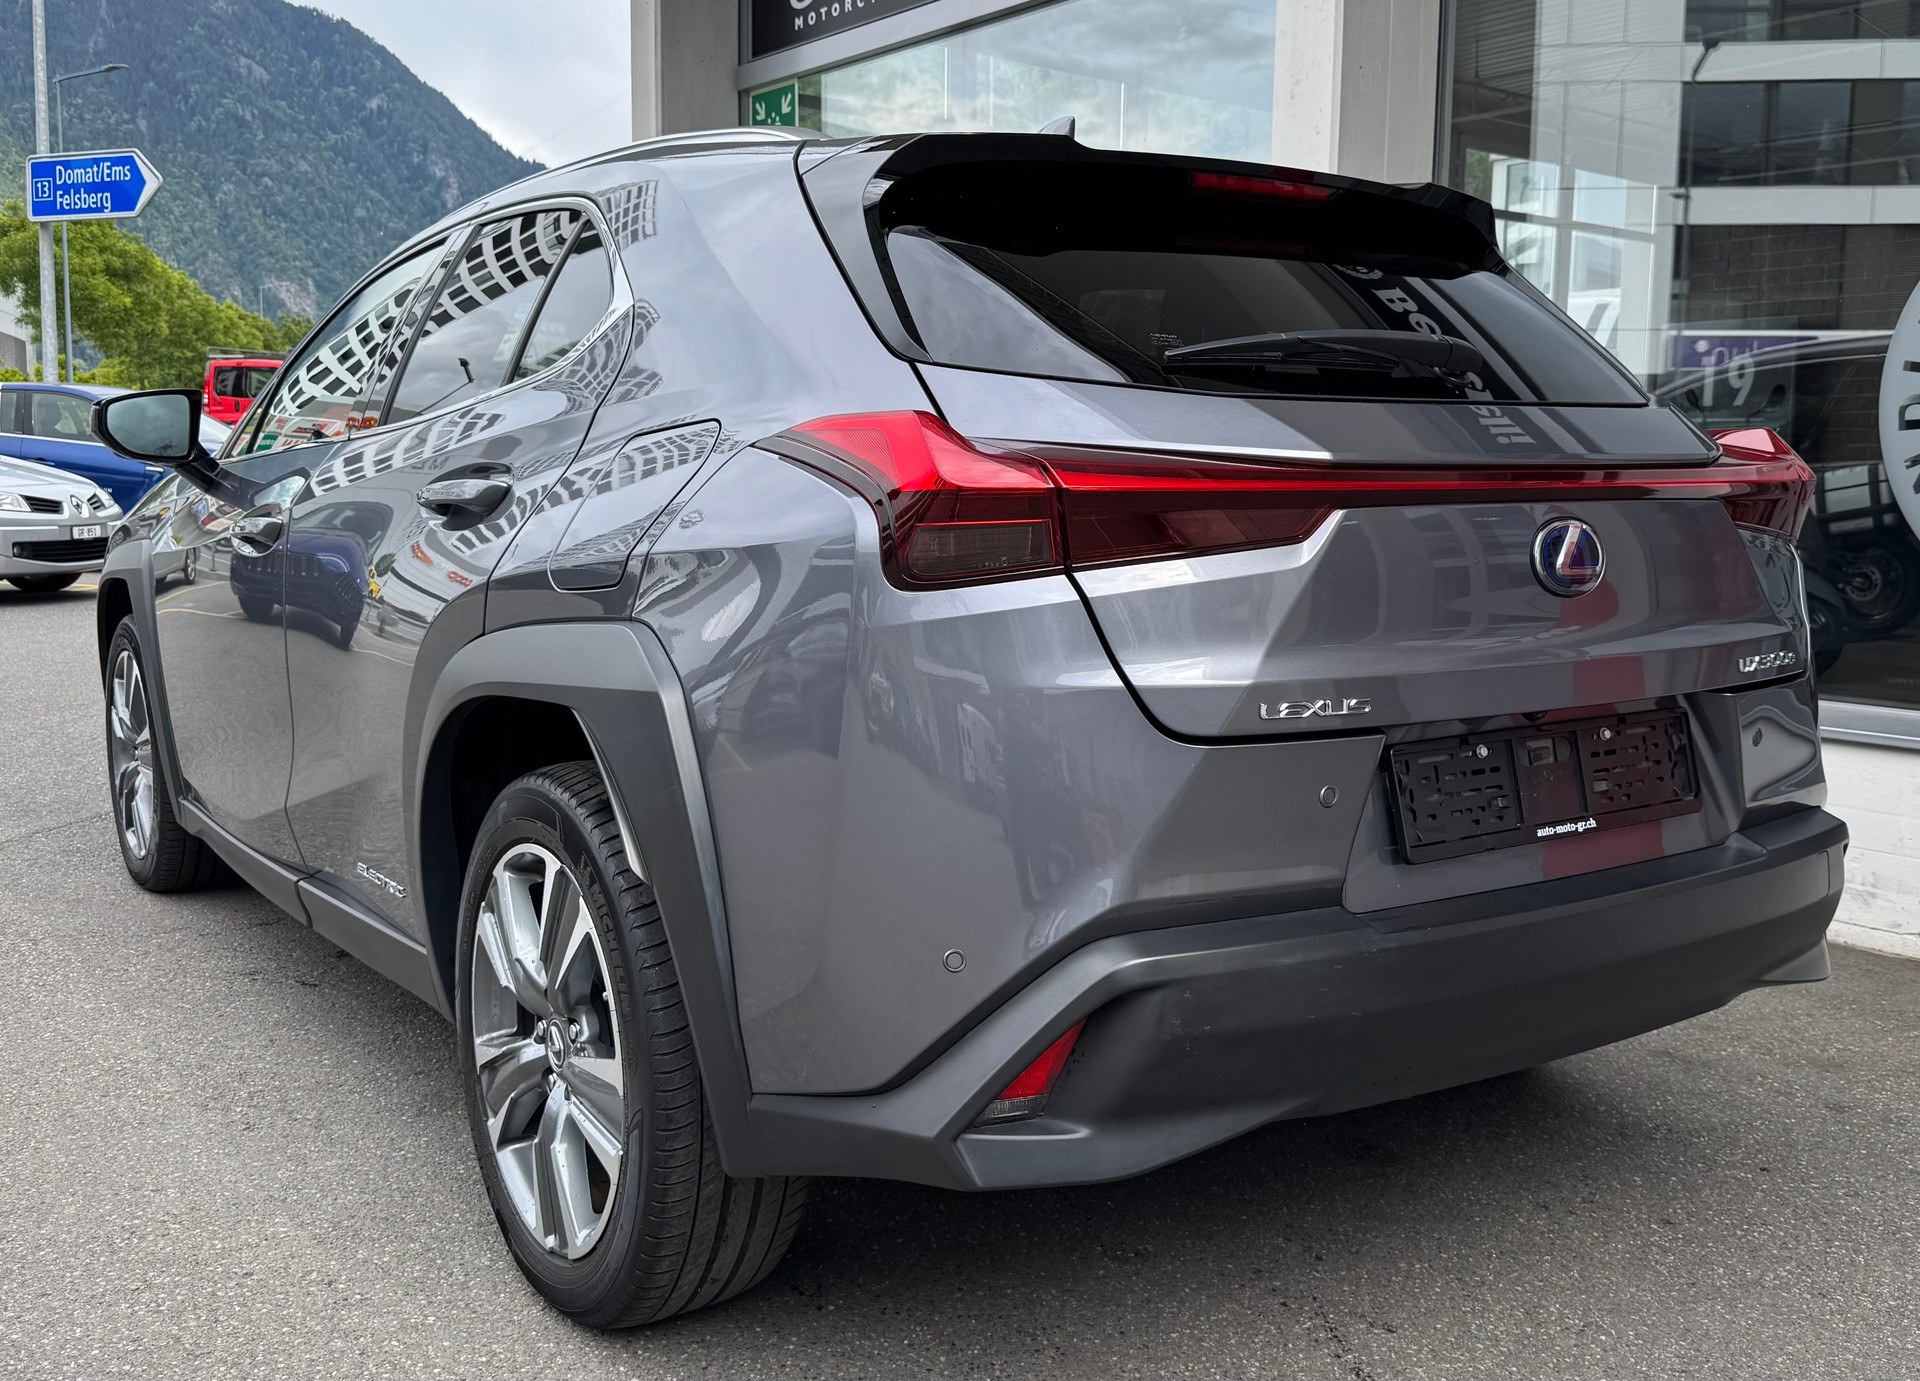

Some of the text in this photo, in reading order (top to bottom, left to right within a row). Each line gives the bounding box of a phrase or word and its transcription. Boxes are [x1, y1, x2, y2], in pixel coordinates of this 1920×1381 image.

[794, 0, 876, 31] MOTORC
[55, 161, 131, 186] Domat/Ems
[36, 181, 50, 198] 13
[56, 188, 111, 213] Felsberg
[1259, 698, 1372, 720] LEXUS
[1536, 817, 1598, 837] auto-moto-gr.ch
